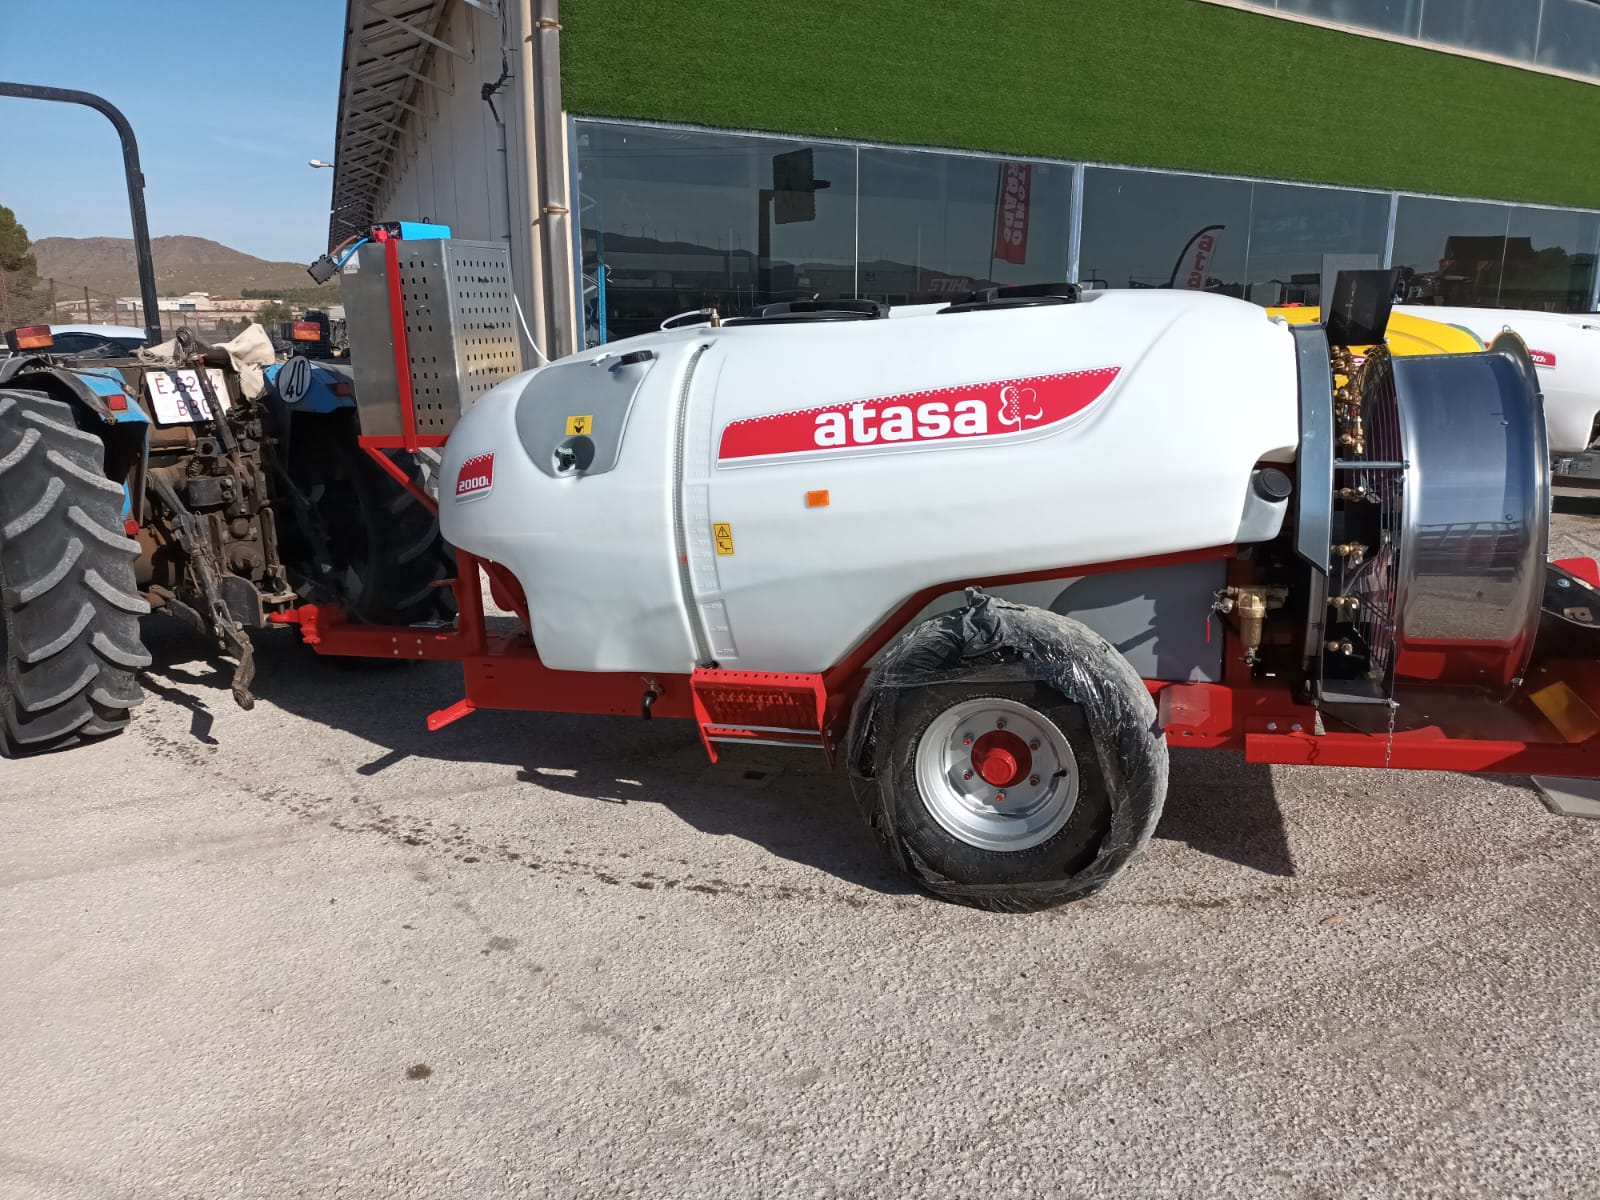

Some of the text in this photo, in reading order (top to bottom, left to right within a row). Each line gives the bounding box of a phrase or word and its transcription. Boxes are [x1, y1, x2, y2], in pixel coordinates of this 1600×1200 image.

[155, 377, 168, 395] E
[285, 359, 305, 399] 40
[814, 399, 988, 447] atasa
